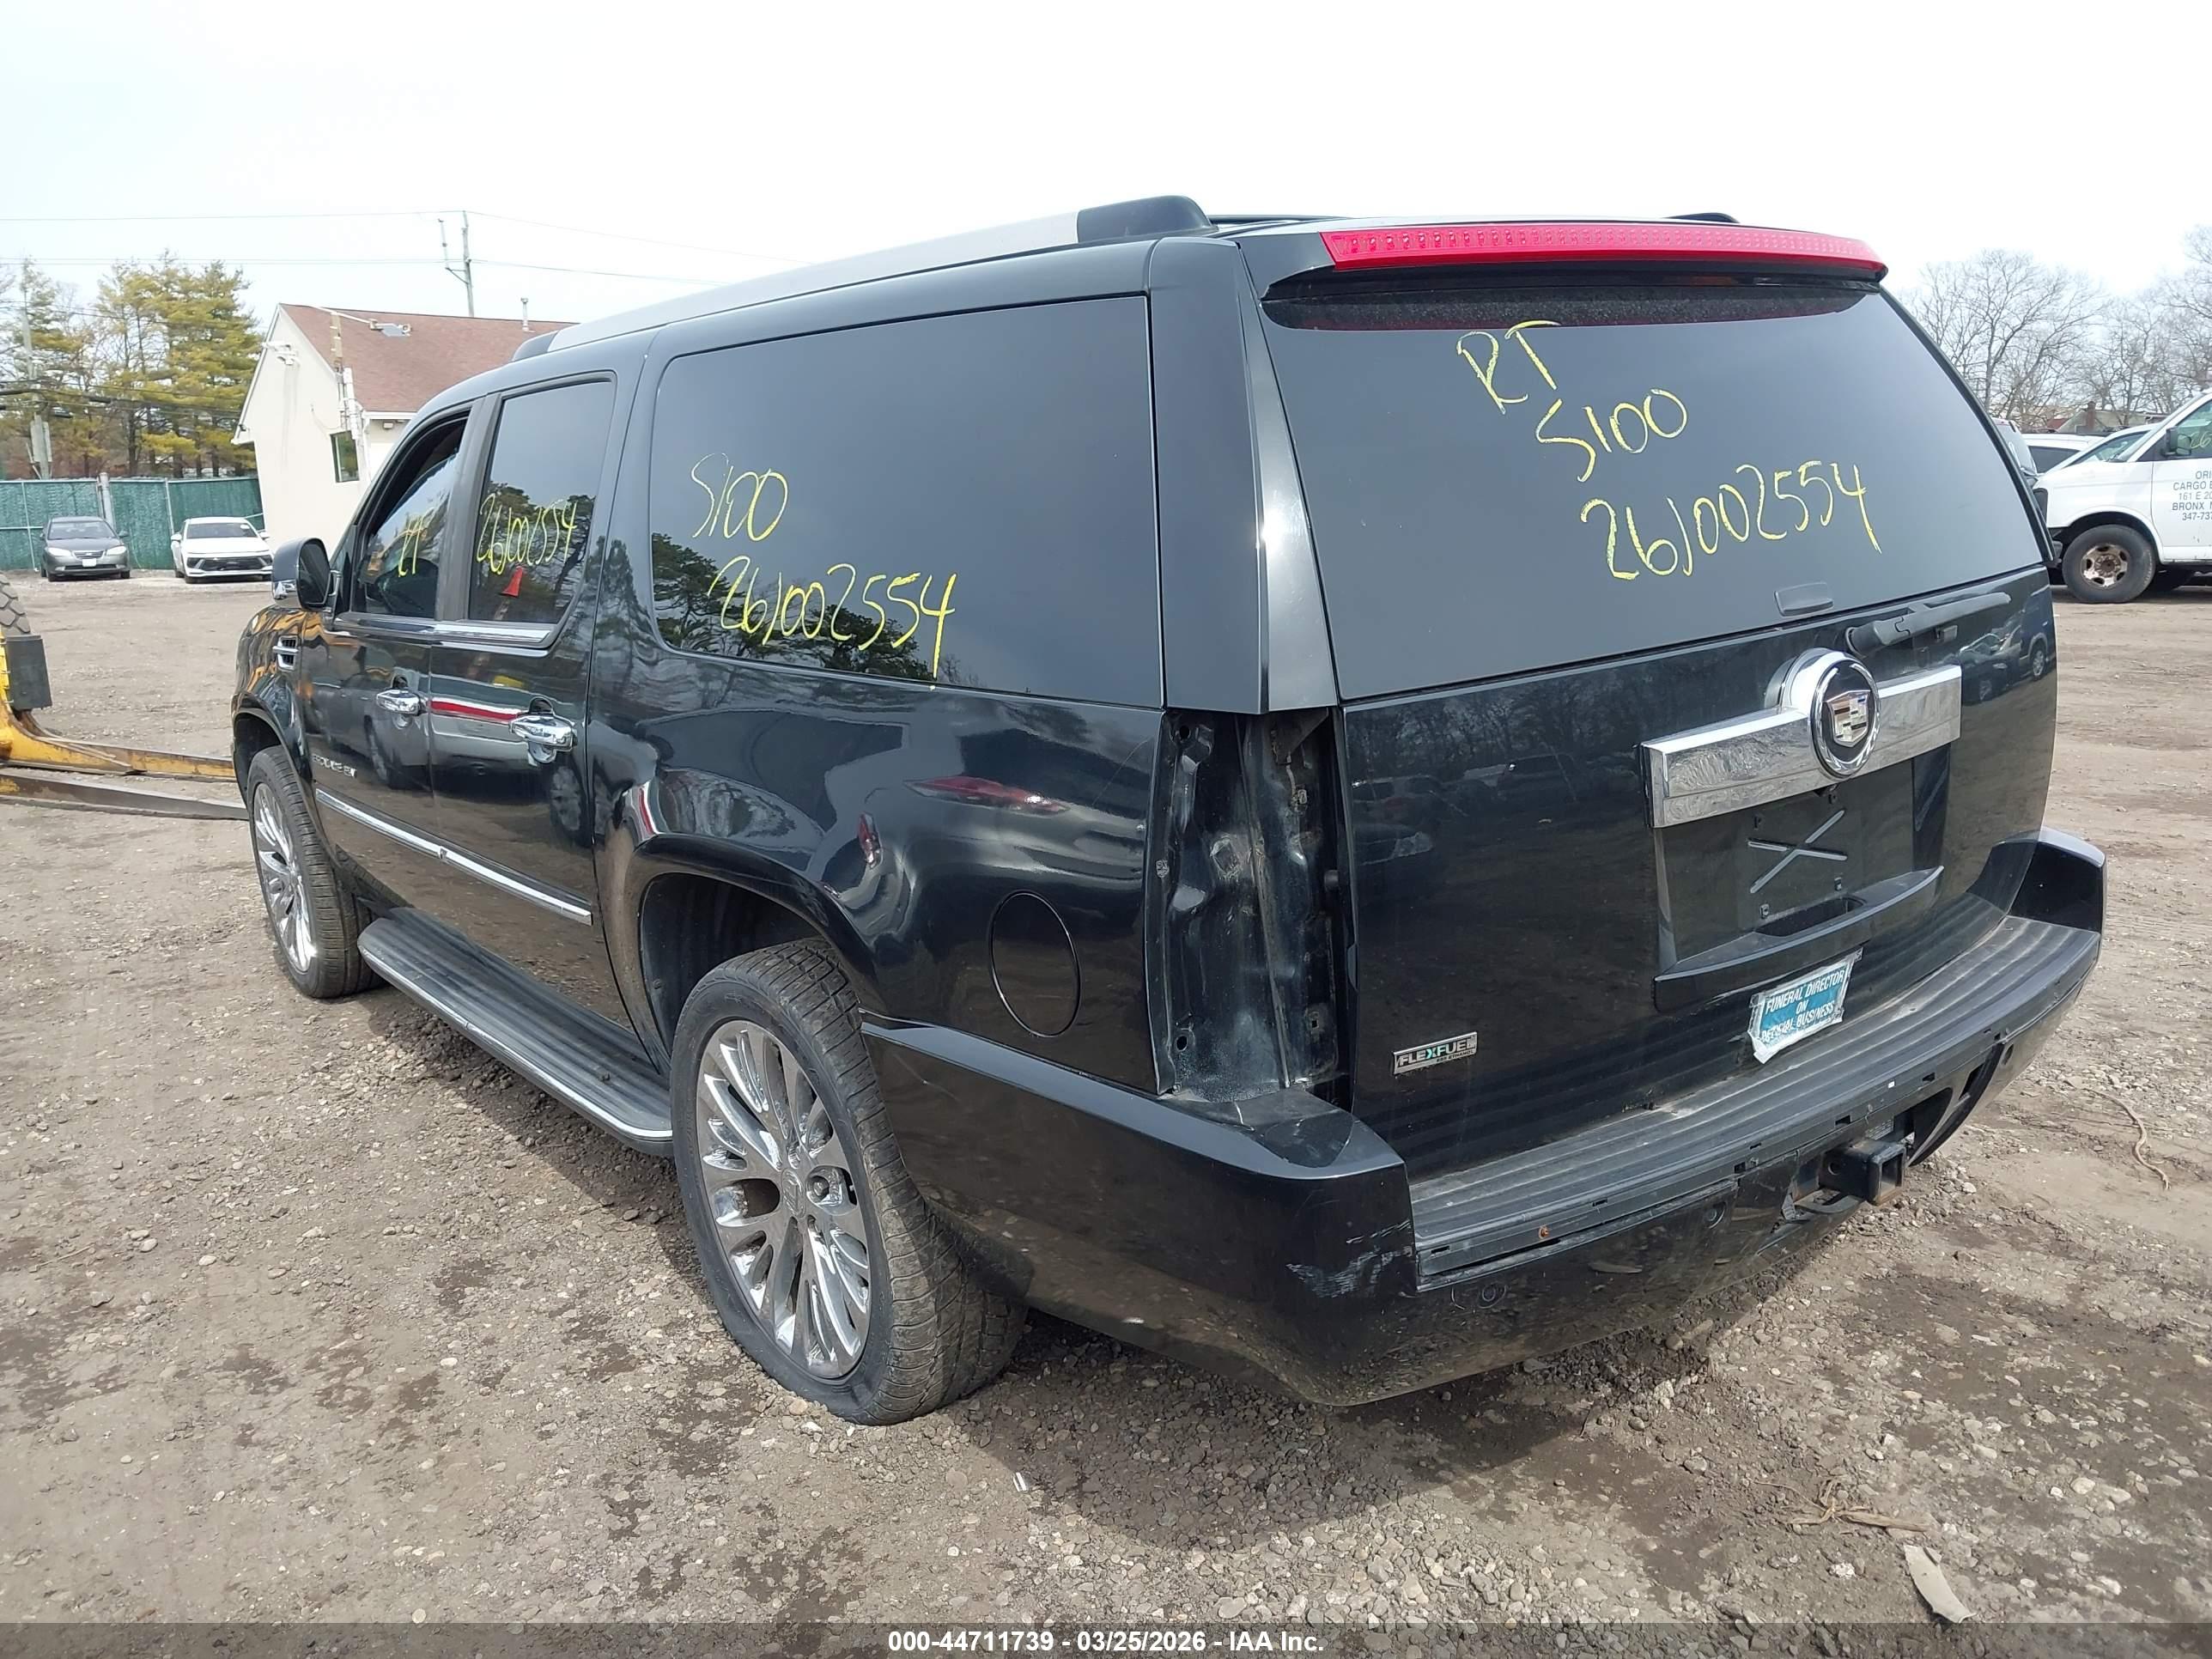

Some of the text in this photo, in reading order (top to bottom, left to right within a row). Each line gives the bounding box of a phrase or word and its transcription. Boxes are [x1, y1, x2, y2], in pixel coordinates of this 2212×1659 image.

[1456, 320, 1561, 414] RT
[2173, 481, 2206, 490] CARGO
[2172, 501, 2204, 510] BRONX
[2182, 512, 2212, 520] 347-73
[1765, 969, 1845, 1015] FUNERAL DIRECTOR
[1796, 1000, 1809, 1015] ON
[1796, 1000, 1835, 1028] BUSINESS
